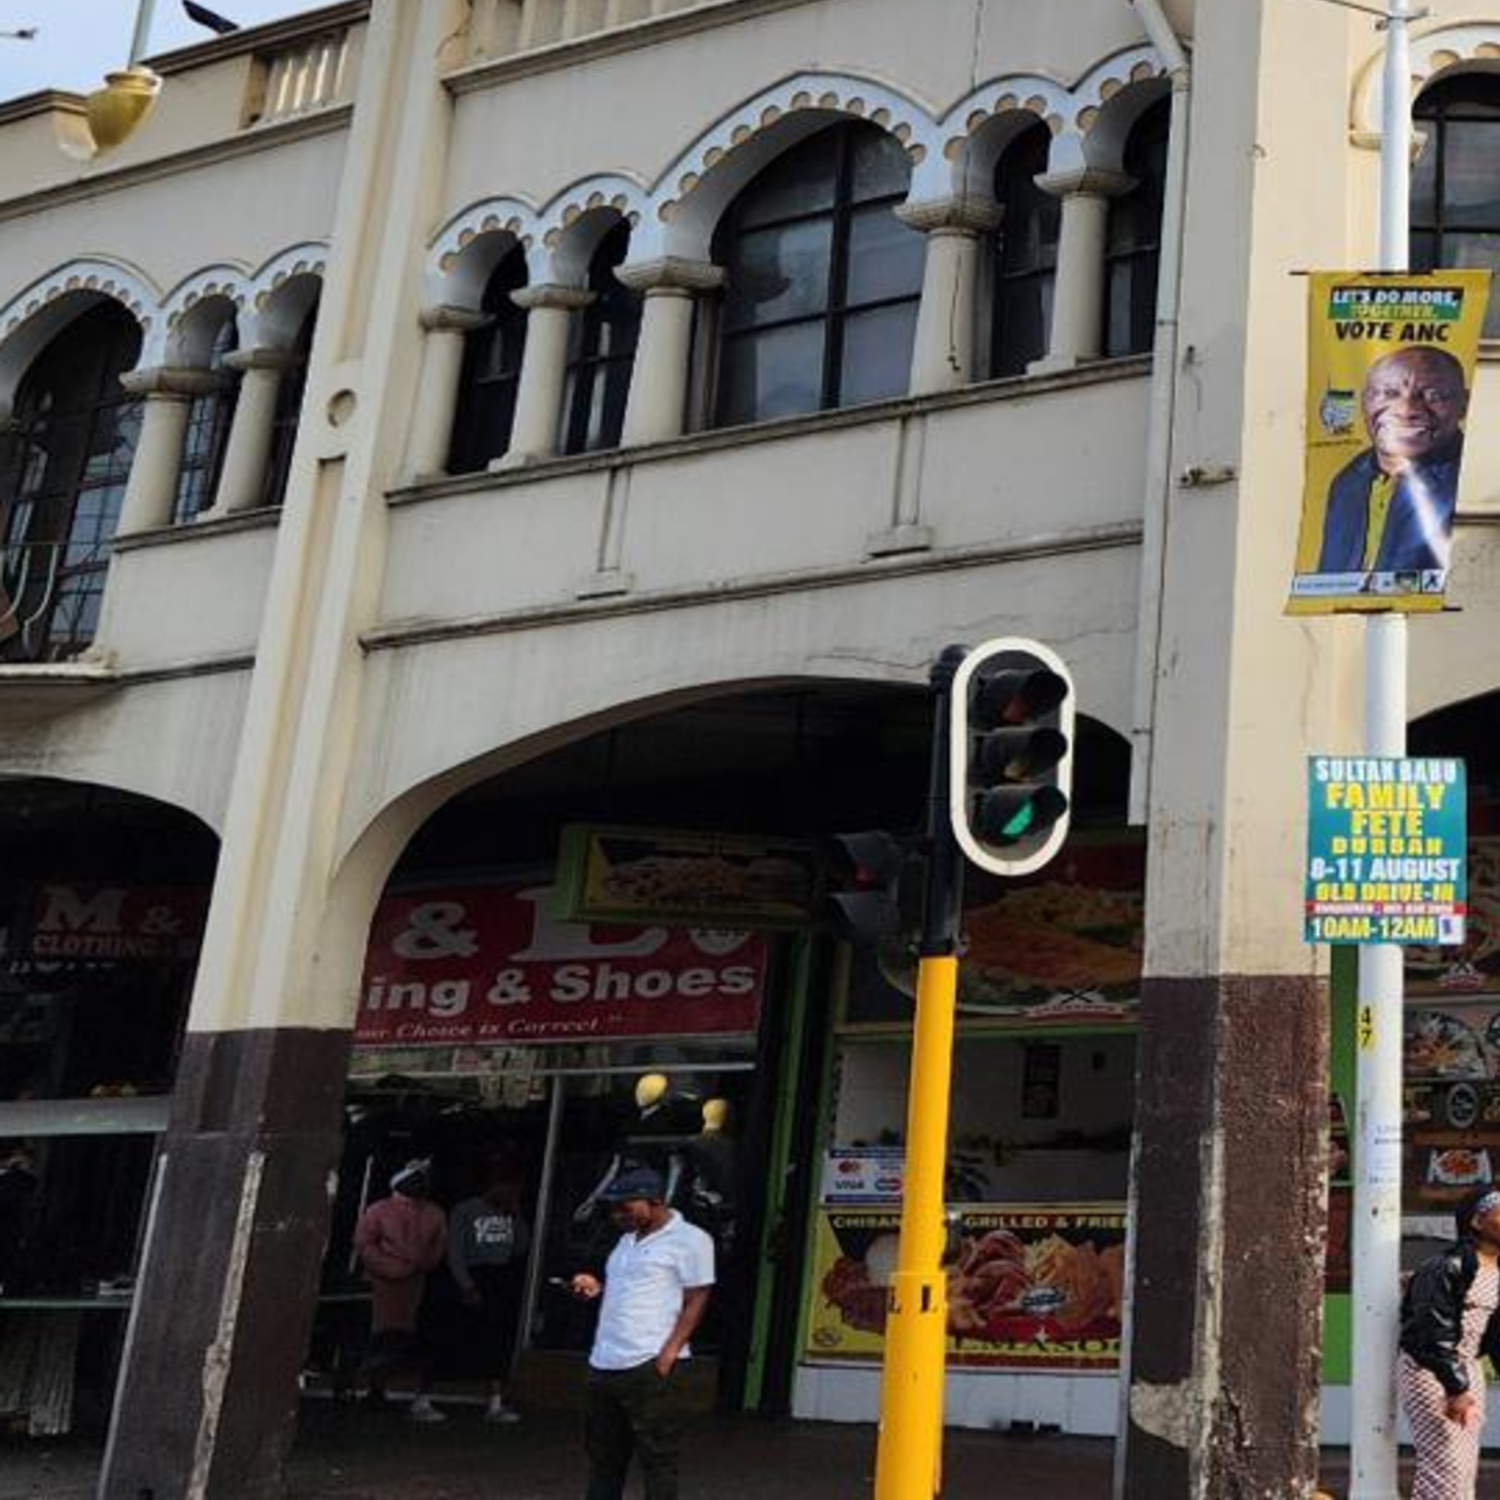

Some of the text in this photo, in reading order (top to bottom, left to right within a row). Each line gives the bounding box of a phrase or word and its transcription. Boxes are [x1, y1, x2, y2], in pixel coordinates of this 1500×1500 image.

[1332, 289, 1371, 304] LET'S
[1374, 289, 1401, 304] DO
[1335, 321, 1450, 342] VOTE ANC
[1315, 758, 1457, 783] SULTAN BAHU
[1326, 782, 1445, 810] FAMILY
[1352, 810, 1424, 837] FETE
[1331, 837, 1443, 856] DURBAN
[1369, 857, 1461, 881] AUGUST
[1315, 882, 1455, 901] OLD DRIVE-IN
[391, 899, 479, 960] &
[1312, 916, 1436, 939] 10AM-12AM
[366, 962, 756, 1017] ing & Shoes
[396, 1022, 473, 1038] Choice
[479, 1021, 499, 1035] is
[507, 1016, 599, 1035] Correct
[966, 1215, 1048, 1229] GRILLED
[1054, 1215, 1069, 1229] &
